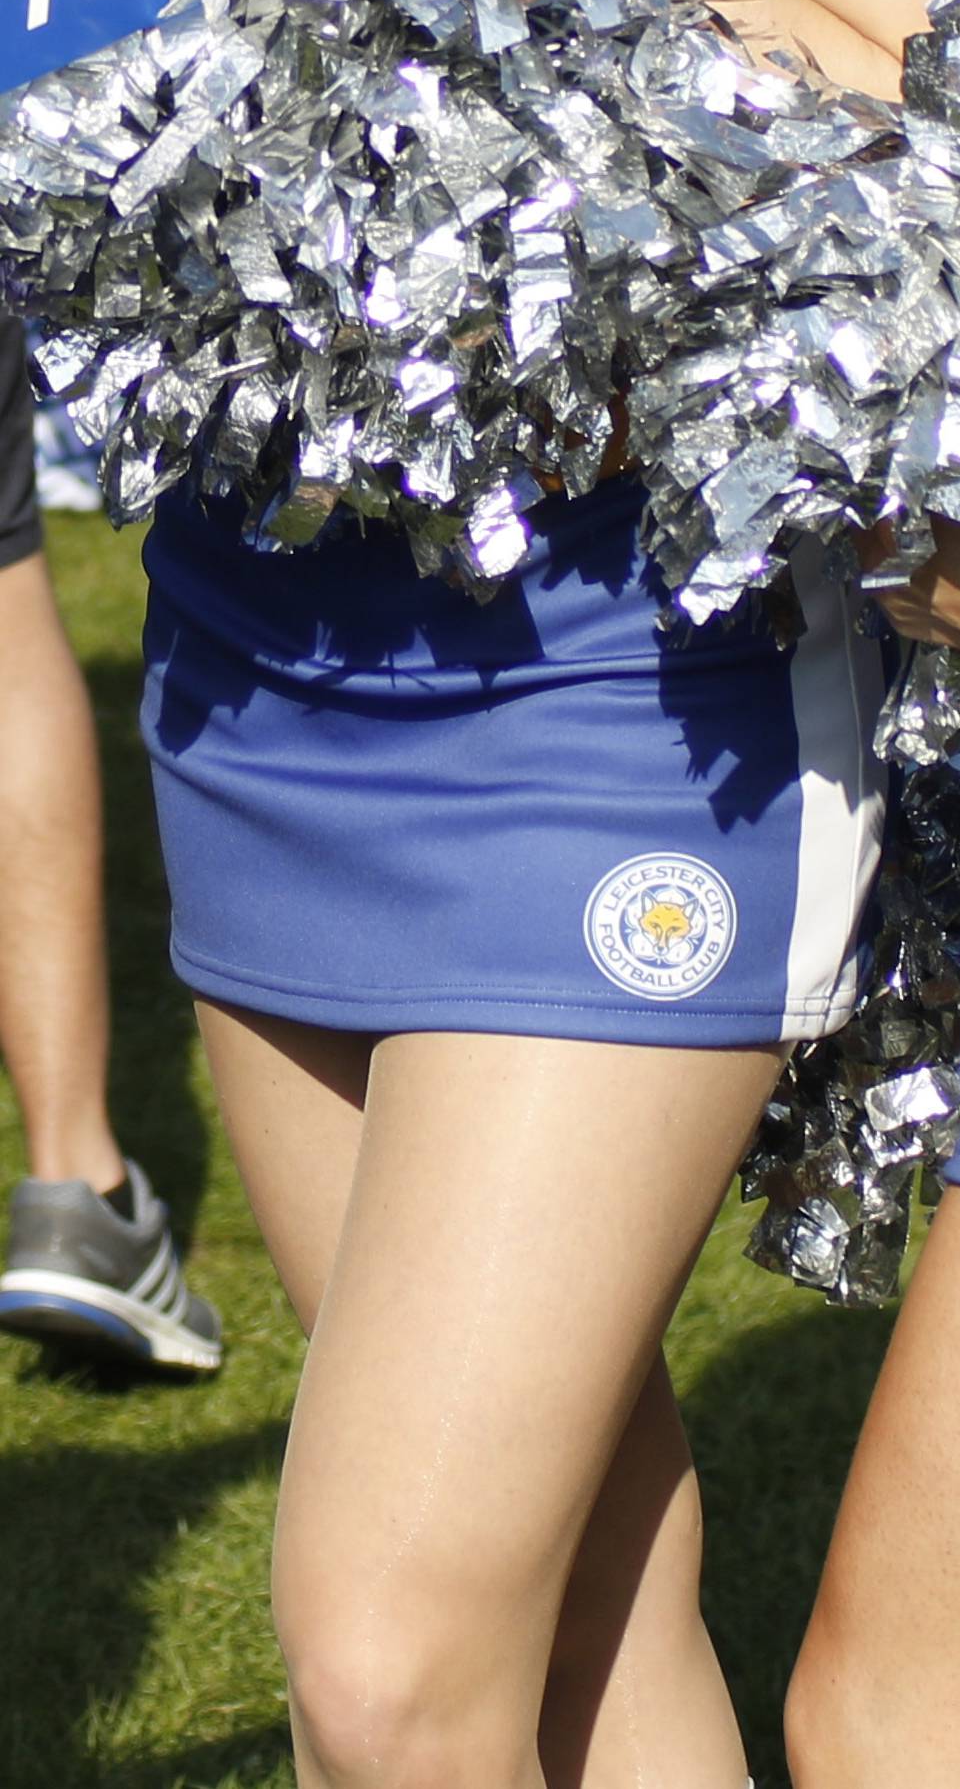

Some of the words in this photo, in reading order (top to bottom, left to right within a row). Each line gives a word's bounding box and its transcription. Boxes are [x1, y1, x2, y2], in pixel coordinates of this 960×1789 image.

[603, 866, 706, 911] LEICESTER
[704, 888, 725, 931] CITY
[599, 923, 680, 987] FOOTBALL
[681, 941, 720, 981] CLUB
